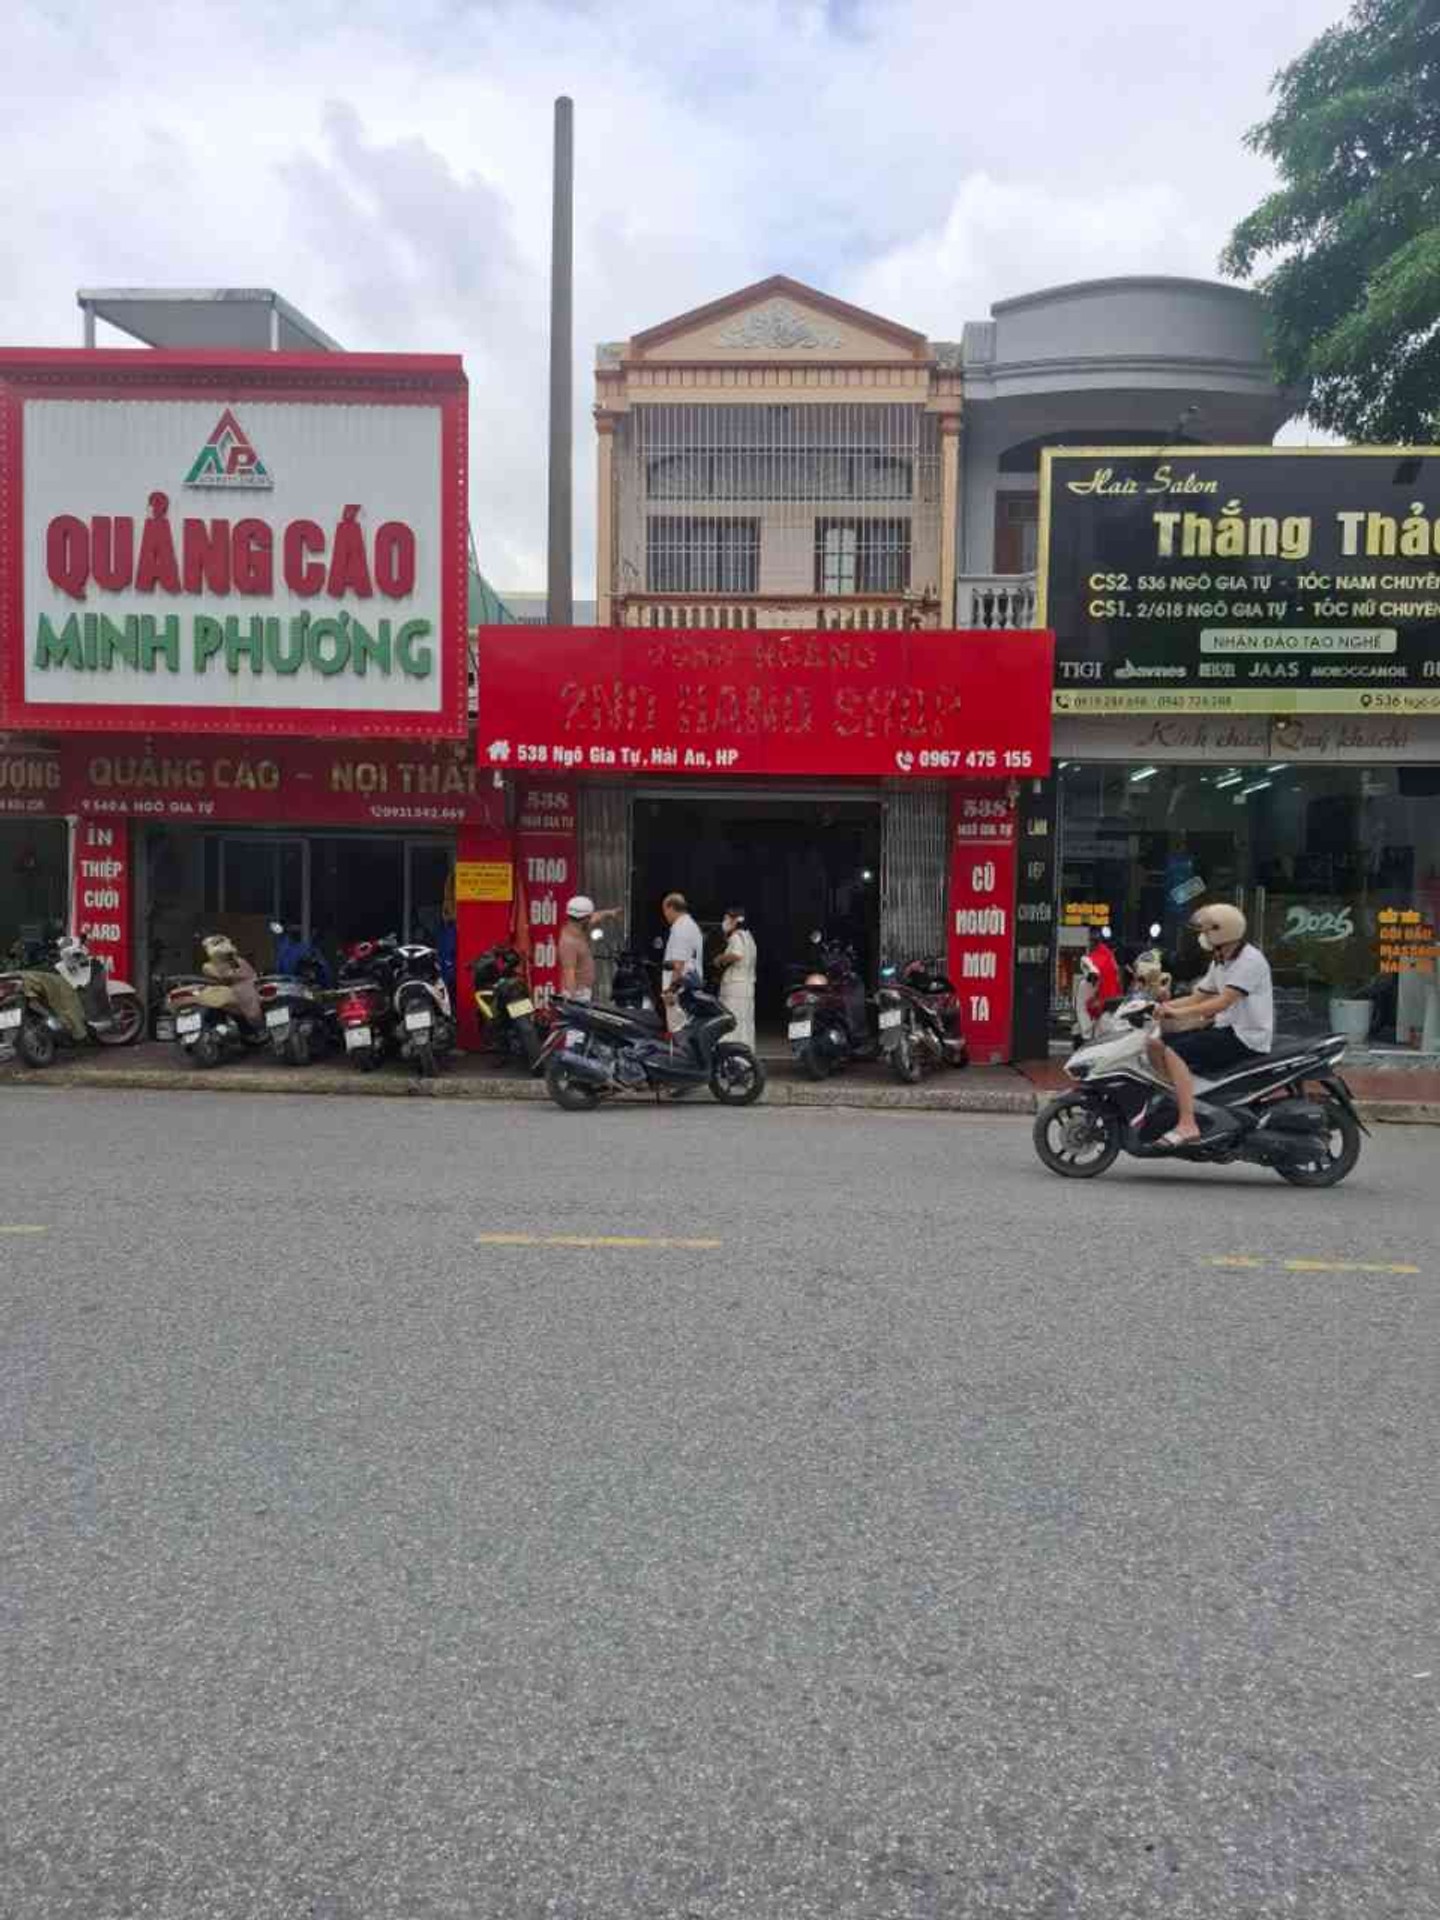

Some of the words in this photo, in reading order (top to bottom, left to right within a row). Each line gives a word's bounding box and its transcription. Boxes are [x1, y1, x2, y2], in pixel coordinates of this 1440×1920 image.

[1068, 467, 1138, 494] Hair
[1146, 466, 1218, 494] Salon
[1153, 499, 1311, 560] Thắng
[46, 491, 274, 600] QUẢNG
[284, 503, 416, 599] CÁO
[1089, 573, 1132, 591] CS2.
[1138, 576, 1166, 591] 536
[1170, 571, 1211, 591] NGÔ
[1216, 575, 1247, 591] GIA
[1252, 575, 1271, 592] TỰ
[1297, 570, 1331, 590] TÓC
[1336, 575, 1376, 590] NAM
[1089, 600, 1131, 618] CS1.
[1138, 602, 1183, 618] 2/618
[1186, 599, 1229, 618] NGÔ
[1233, 602, 1262, 618] GIA
[1266, 602, 1287, 619] TỰ
[1313, 598, 1348, 617] TÓC
[1351, 599, 1377, 617] NỮ
[34, 612, 180, 673] MINH
[194, 610, 432, 677] PHƯƠNG
[1059, 661, 1102, 678] TIGI
[88, 738, 206, 789] QUẢNG
[213, 740, 280, 792] CÁO
[517, 745, 547, 761] 538
[553, 744, 583, 766] Ngô
[590, 746, 615, 764] Gia
[651, 747, 677, 765] Hải
[684, 749, 711, 767] An,
[716, 749, 739, 765] HP
[919, 750, 962, 770] 0967
[967, 751, 998, 770] 475
[1003, 752, 1033, 770] 155
[170, 801, 193, 813] GIA
[527, 858, 568, 883] TRAO
[972, 862, 995, 891] CŨ
[530, 890, 557, 925] ĐỔI
[955, 908, 1006, 935] NGƯỜI
[969, 996, 990, 1021] TA
